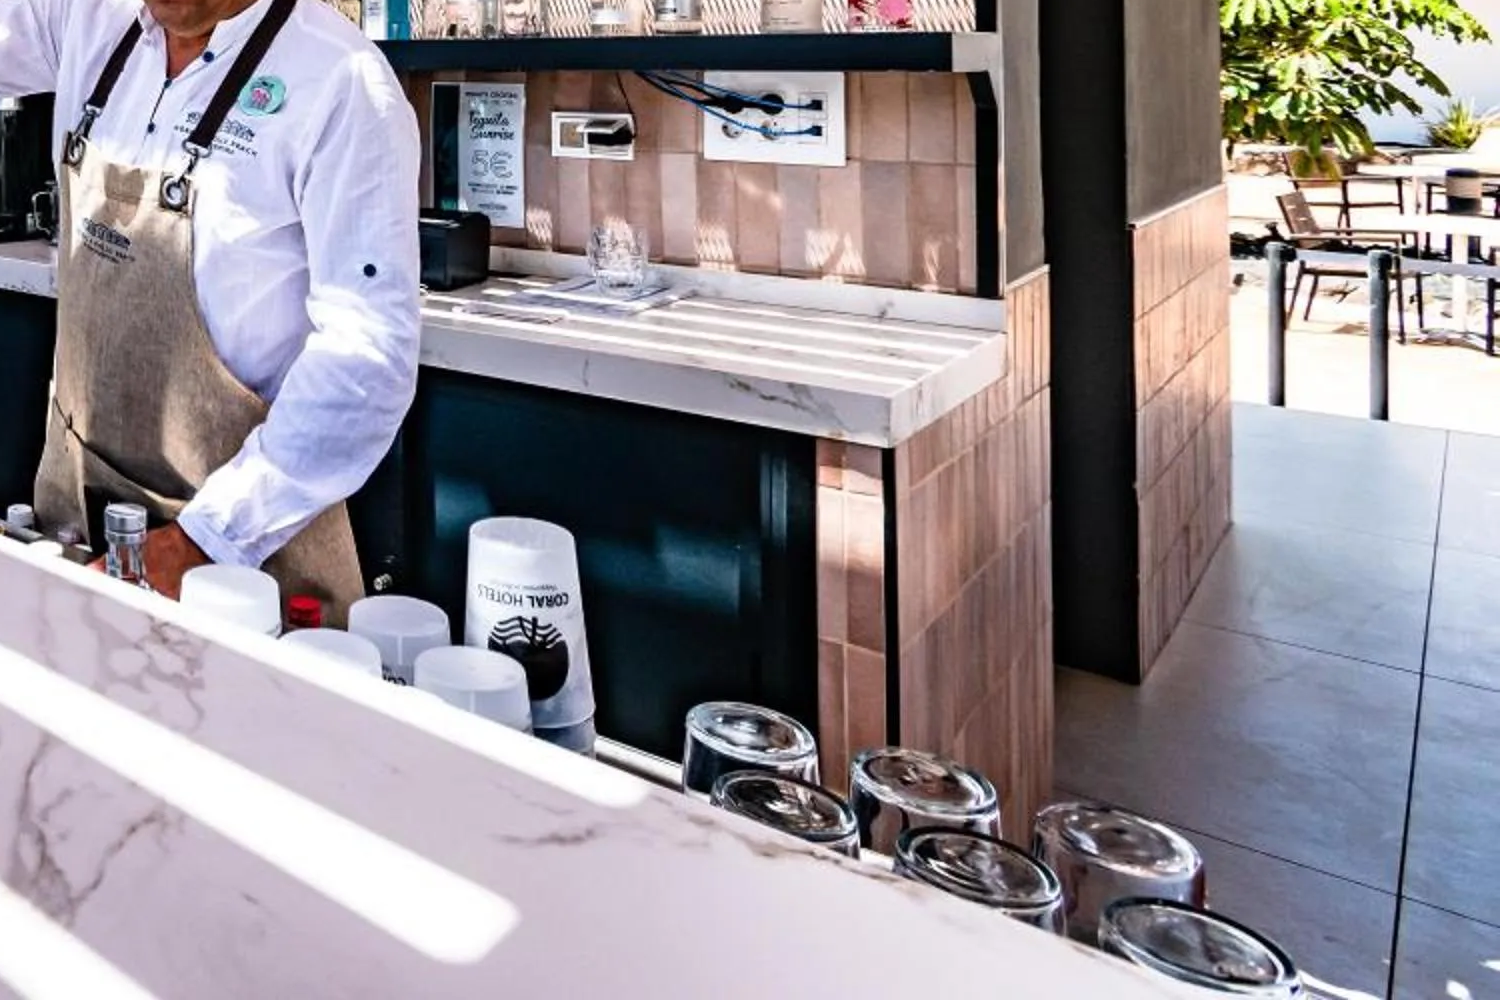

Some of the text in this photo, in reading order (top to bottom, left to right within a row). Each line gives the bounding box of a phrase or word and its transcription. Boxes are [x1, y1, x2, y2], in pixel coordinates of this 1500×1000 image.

[471, 149, 513, 179] 5€
[477, 583, 523, 607] HOTELS
[526, 592, 569, 608] CORAL
